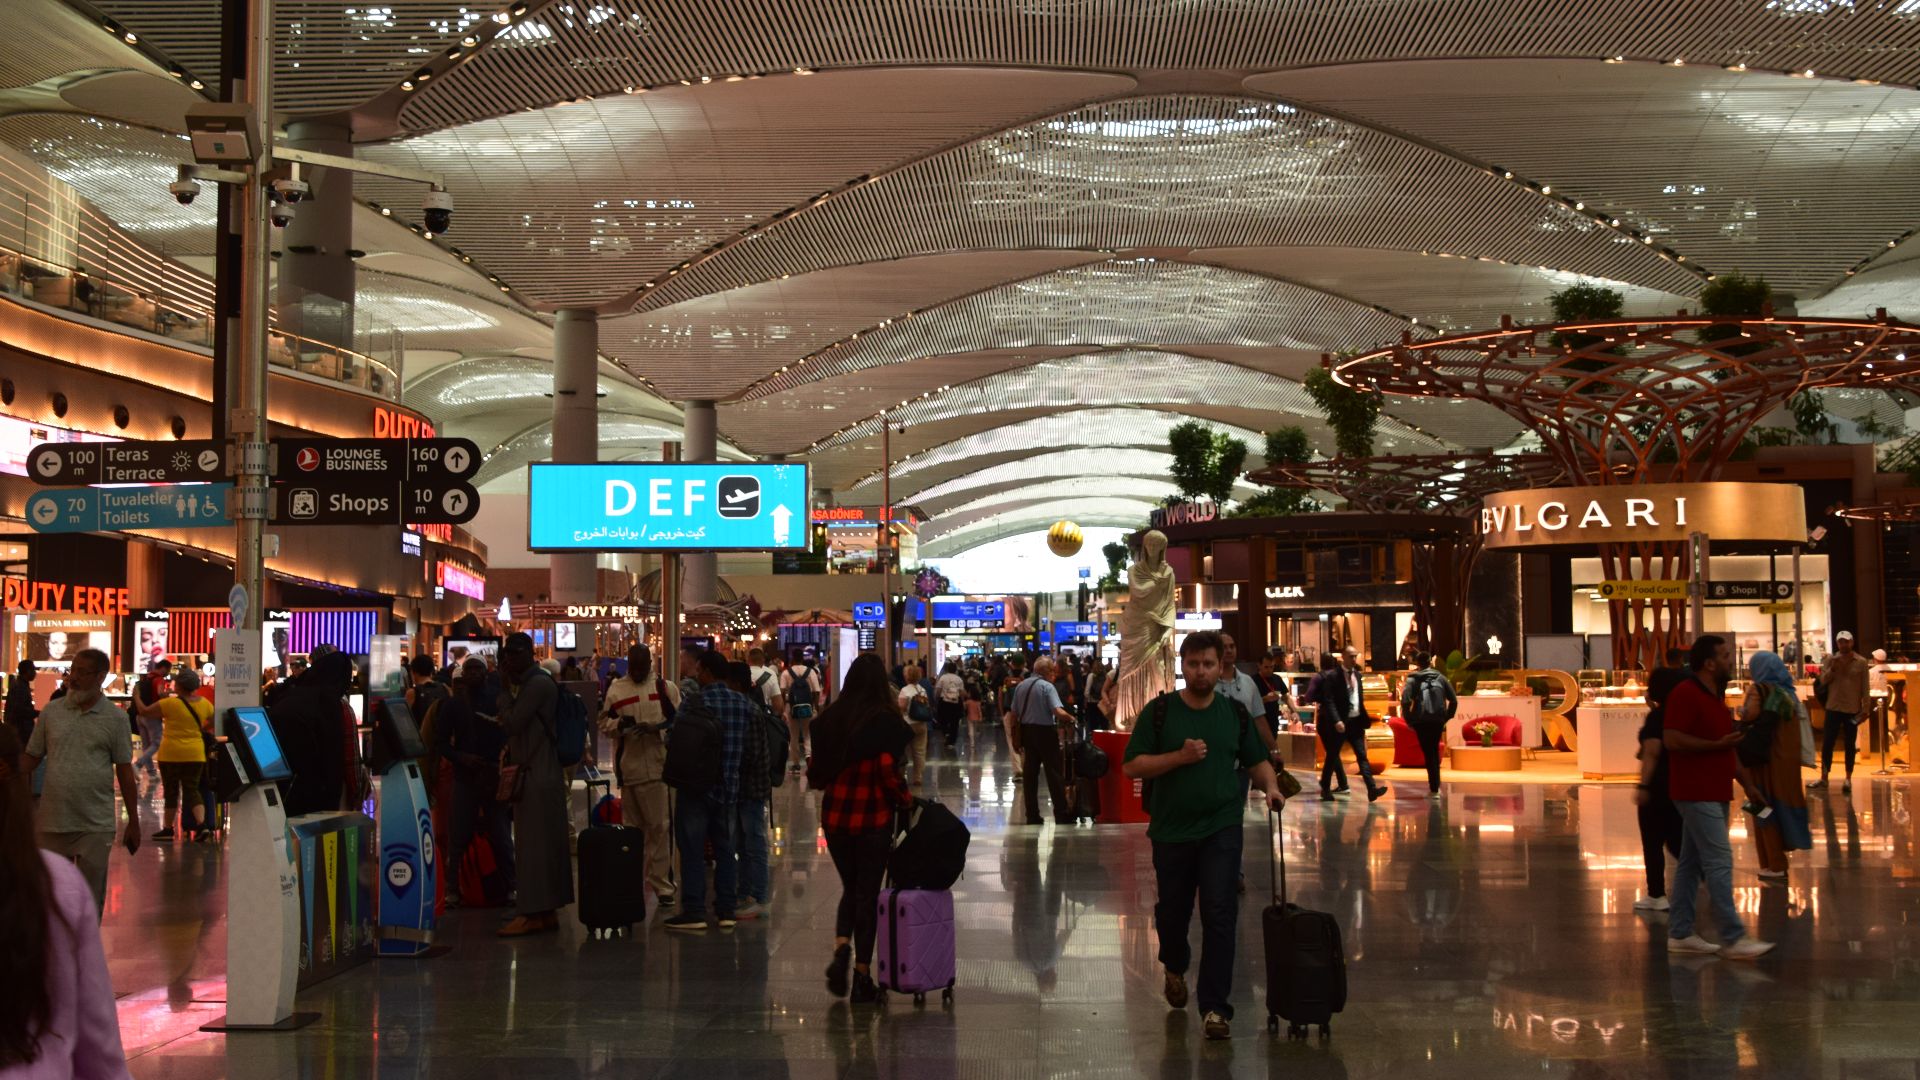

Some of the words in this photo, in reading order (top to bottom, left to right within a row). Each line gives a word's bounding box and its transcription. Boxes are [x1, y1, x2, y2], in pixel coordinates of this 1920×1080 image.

[374, 407, 419, 438] DUTY
[68, 451, 95, 464] 100
[106, 447, 149, 462] Teras
[326, 448, 381, 460] LOUNGE
[412, 448, 439, 461] 160
[73, 467, 85, 476] m
[326, 459, 388, 471] BUSINESS
[417, 464, 428, 472] m
[106, 466, 166, 481] Terrace
[102, 493, 173, 508] Tuvaletler
[414, 489, 433, 502] 10
[605, 479, 637, 517] D
[649, 478, 673, 516] E
[684, 479, 706, 516] F
[67, 498, 86, 512] 70
[329, 493, 389, 515] Shops
[415, 506, 426, 514] m
[69, 515, 80, 524] m
[102, 510, 150, 525] Toilets
[829, 507, 864, 520] DÖNER
[1166, 501, 1217, 526] WORLD
[1481, 497, 1687, 535] BVLGARI
[1634, 585, 1655, 594] Food
[1657, 585, 1680, 594] Court
[1731, 585, 1757, 596] Shops
[4, 577, 66, 614] DUTY
[73, 585, 130, 616] FREE
[567, 605, 608, 618] DUTY
[611, 605, 639, 617] FREE
[874, 605, 884, 616] D
[976, 605, 983, 615] F
[33, 619, 63, 628] HELENA
[231, 643, 245, 655] FREE
